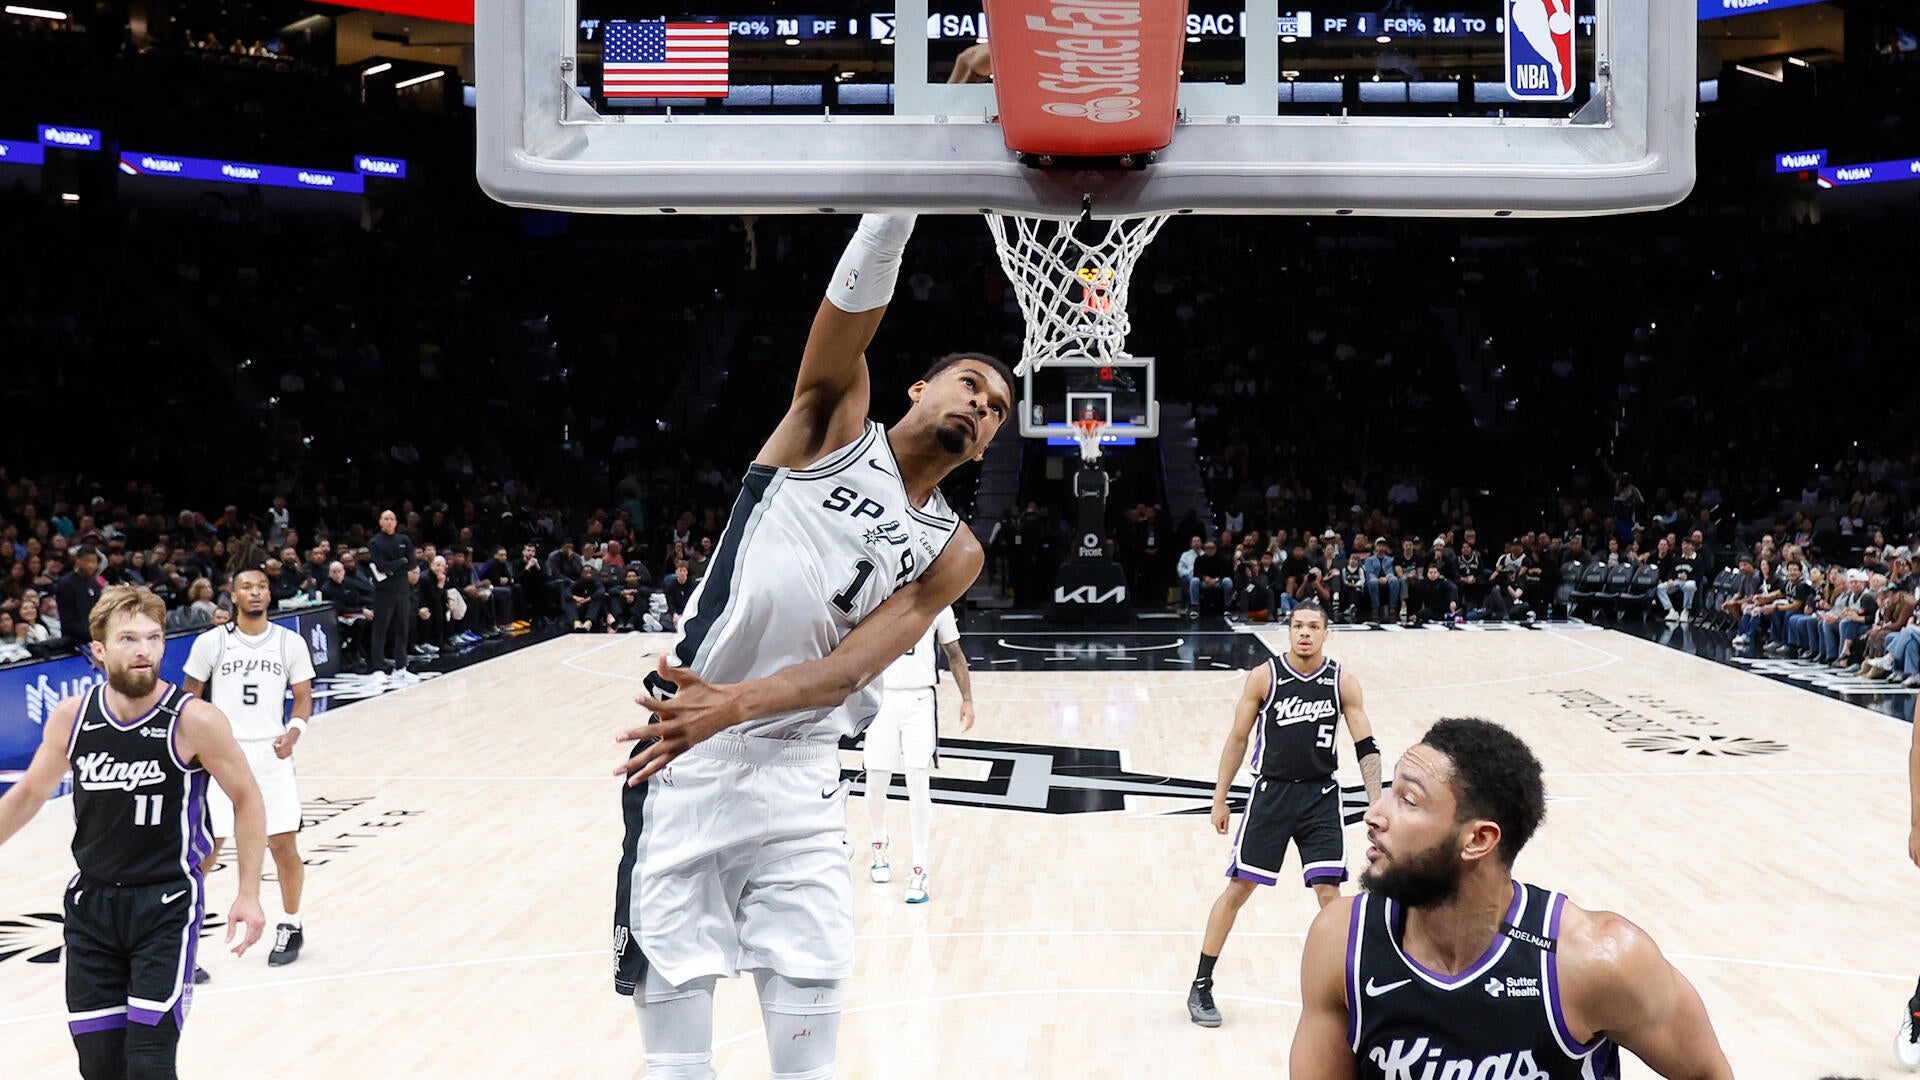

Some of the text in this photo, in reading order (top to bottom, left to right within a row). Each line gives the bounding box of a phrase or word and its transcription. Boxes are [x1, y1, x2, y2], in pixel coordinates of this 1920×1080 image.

[728, 21, 770, 35] FG%
[813, 20, 837, 35] PF
[943, 14, 977, 37] SA
[1186, 13, 1235, 35] SAC
[1324, 18, 1348, 32] PF
[1384, 18, 1427, 32] FG%
[1462, 18, 1487, 32] TO
[1033, 39, 1141, 95] State
[1516, 64, 1550, 90] NBA
[829, 558, 877, 617] 1
[221, 659, 283, 677] SPURS
[242, 684, 259, 706] 5
[1273, 696, 1336, 727] Kings
[1316, 724, 1335, 748] 5
[76, 751, 167, 792] Kings
[134, 794, 164, 826] 11
[1508, 928, 1552, 951] ADELMAN
[1506, 976, 1539, 988] Sutter
[1506, 987, 1541, 998] Health
